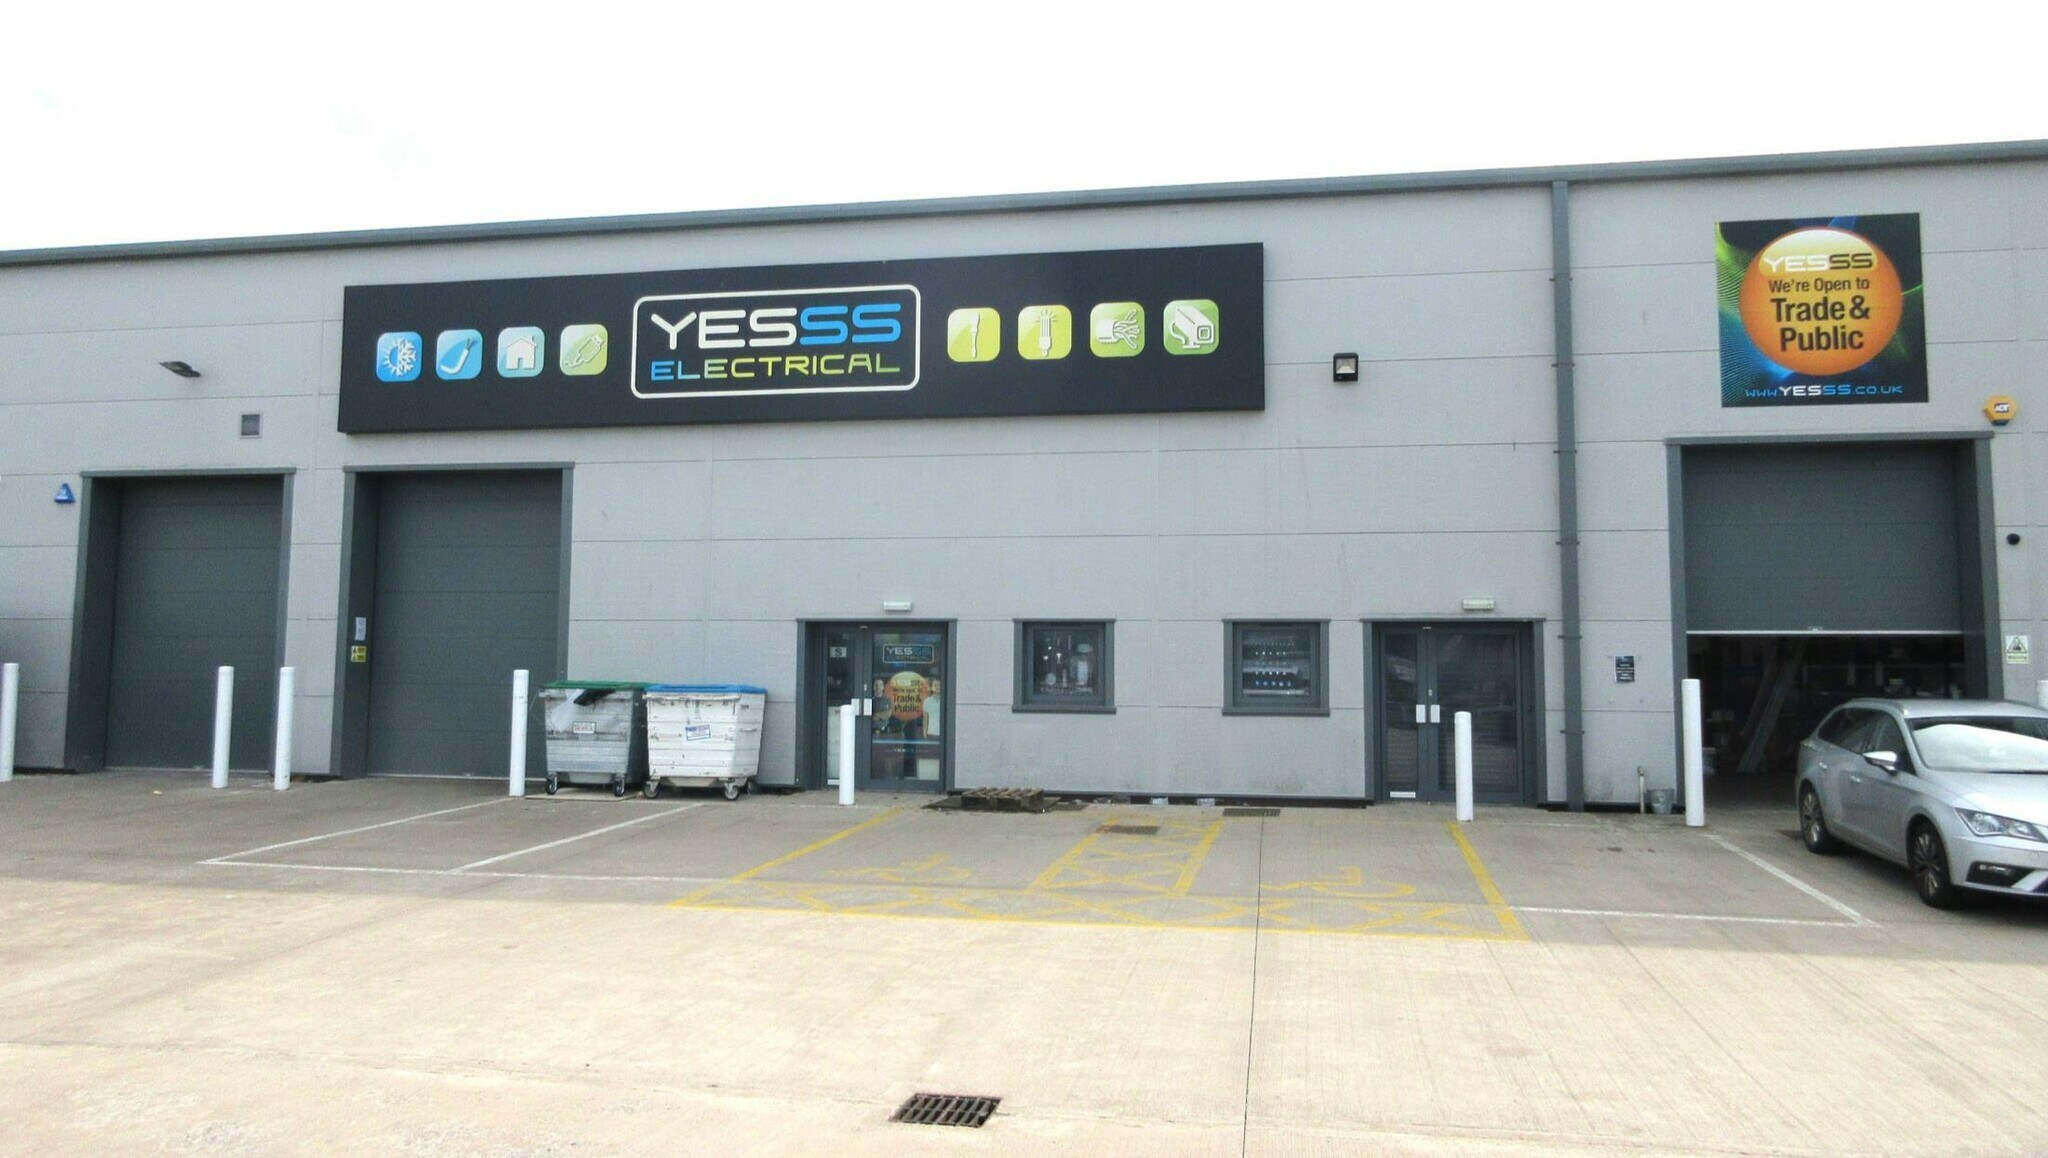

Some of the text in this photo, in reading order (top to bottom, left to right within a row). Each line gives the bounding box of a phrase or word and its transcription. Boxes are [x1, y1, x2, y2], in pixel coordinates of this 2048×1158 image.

[1763, 252, 1873, 272] YESSS
[1768, 276, 1870, 295] We're Open to
[1770, 294, 1870, 323] Trade &
[650, 302, 902, 350] YESSS
[1780, 324, 1864, 353] Public
[650, 353, 901, 381] ELECTRICAL
